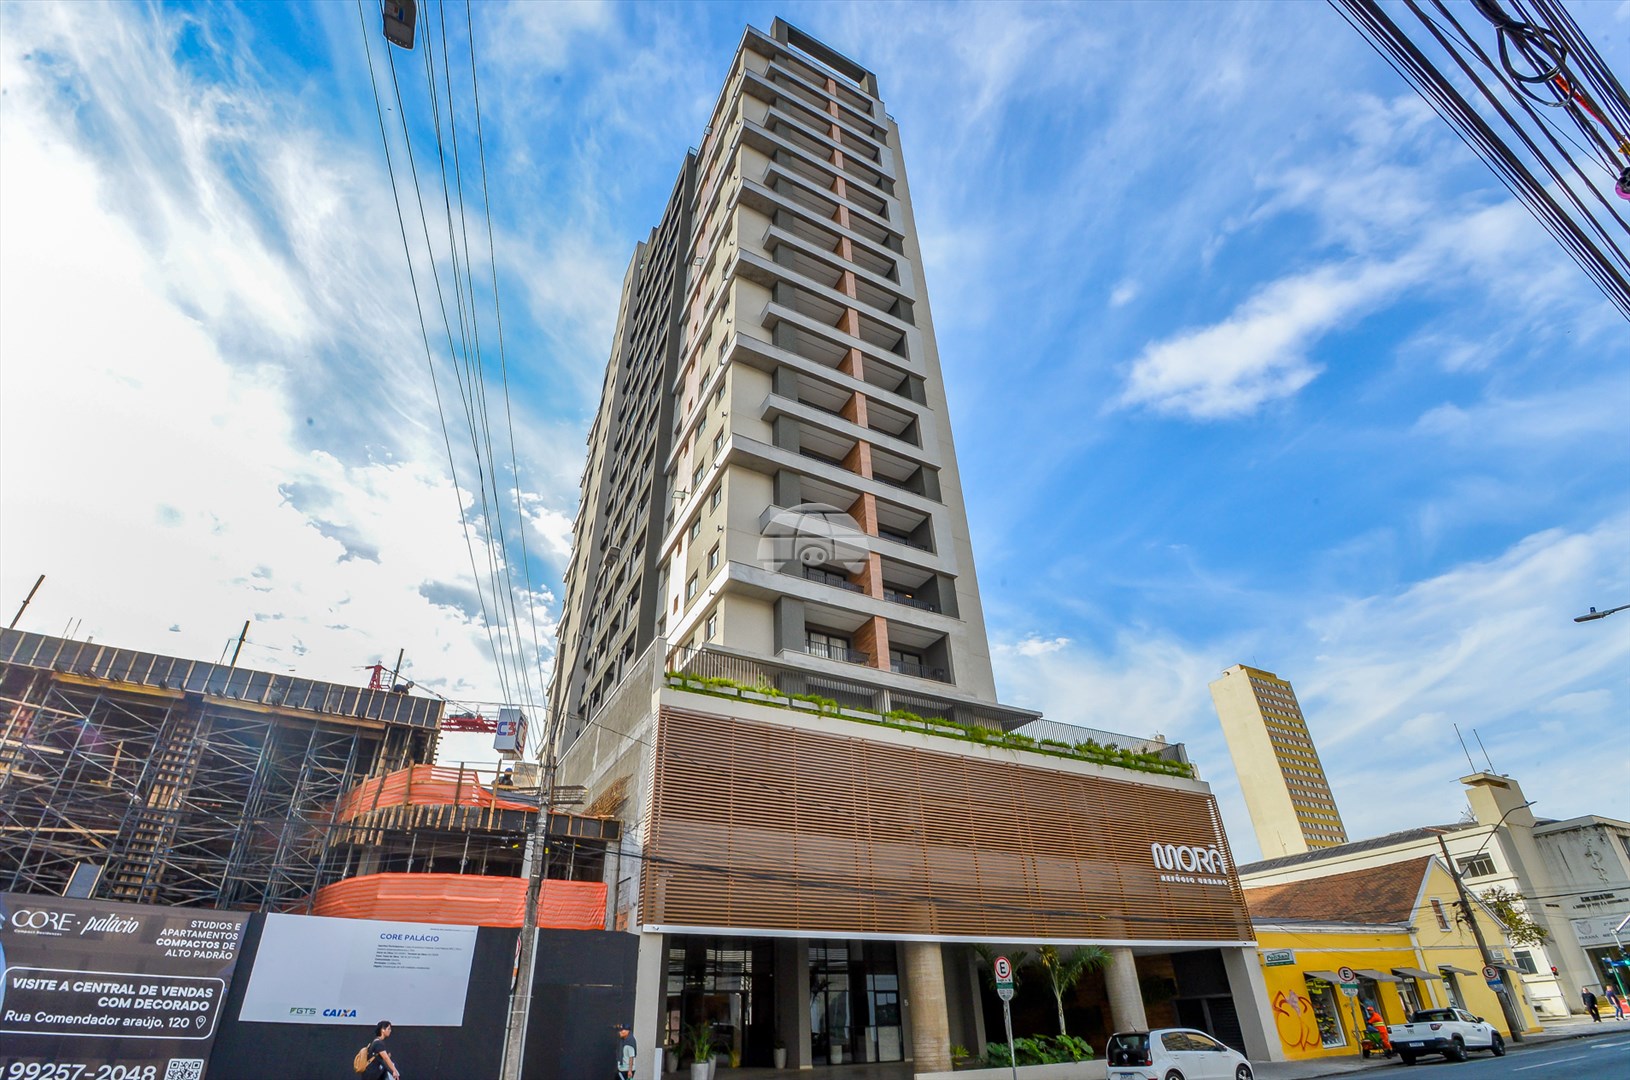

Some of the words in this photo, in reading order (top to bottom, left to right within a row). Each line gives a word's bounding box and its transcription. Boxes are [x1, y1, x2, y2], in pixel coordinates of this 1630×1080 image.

[497, 721, 516, 736] C3
[11, 909, 76, 932] CORE
[80, 913, 140, 936] palácio
[191, 920, 233, 930] STUDIOS
[234, 922, 242, 931] E
[160, 928, 239, 941] APARTAMENTOS
[380, 933, 402, 941] CORE
[404, 932, 440, 942] PALÁCIO
[156, 937, 220, 949] COMPACTOS
[222, 942, 236, 950] DE
[165, 949, 192, 958] ALTO
[193, 949, 233, 960] PADRÃO
[999, 961, 1007, 974] E
[1342, 969, 1350, 978] E
[1485, 968, 1493, 976] E
[12, 978, 57, 991] VISITE
[57, 981, 70, 991] A
[72, 981, 136, 996] CENTRAL
[139, 985, 158, 996] DE
[161, 986, 214, 998] VENDAS
[98, 997, 131, 1009] COM
[134, 998, 210, 1012] DECORADO
[290, 1007, 317, 1015] FGTS
[322, 1008, 357, 1018] CAIXA
[4, 1010, 31, 1023] Rua
[34, 1012, 121, 1026] Comendador
[123, 1014, 164, 1030] araújo,
[168, 1017, 190, 1028] 120
[7, 1062, 157, 1080] 99257-2048
